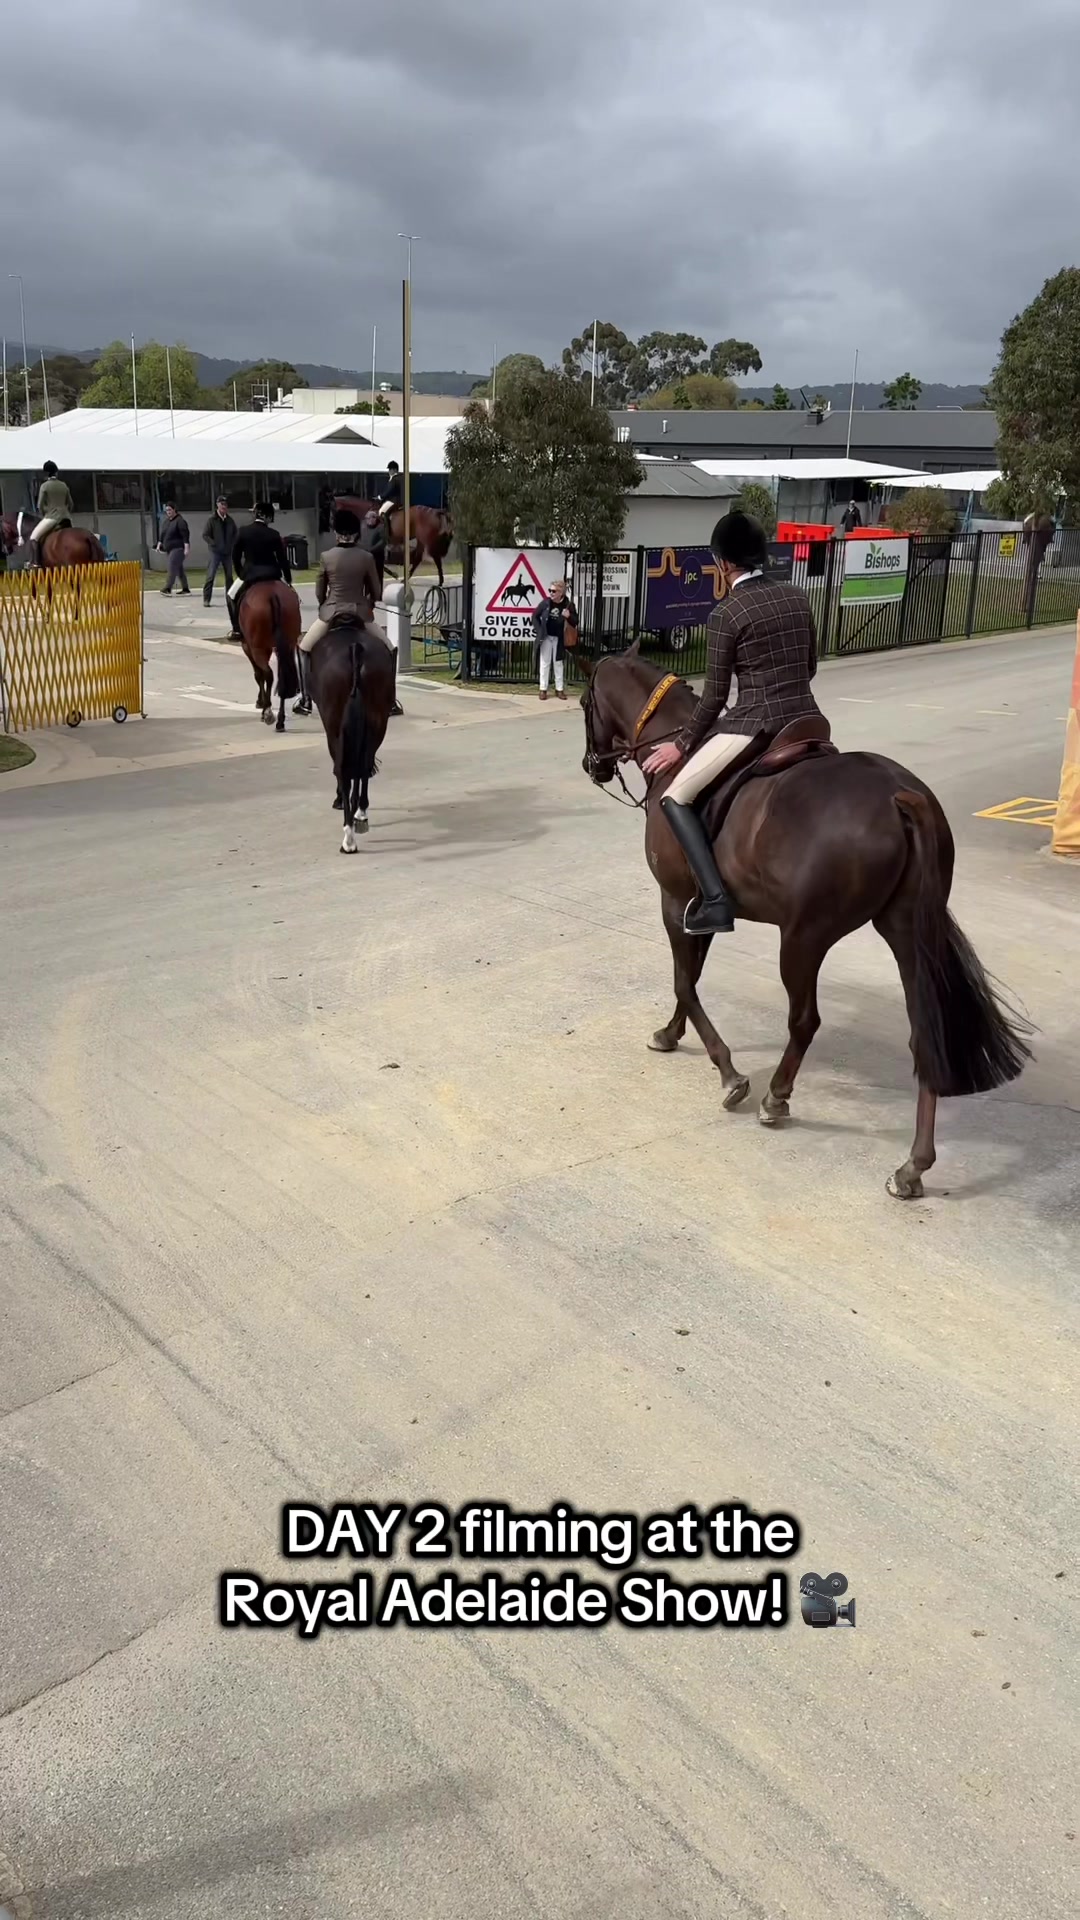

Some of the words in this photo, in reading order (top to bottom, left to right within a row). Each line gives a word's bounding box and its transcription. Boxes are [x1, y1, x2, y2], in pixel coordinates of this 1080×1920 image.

[865, 552, 900, 570] Bishops
[684, 570, 699, 585] jpc
[603, 583, 621, 591] DOWN
[485, 615, 518, 626] GIVE
[479, 626, 498, 637] TO
[502, 627, 538, 638] HORS
